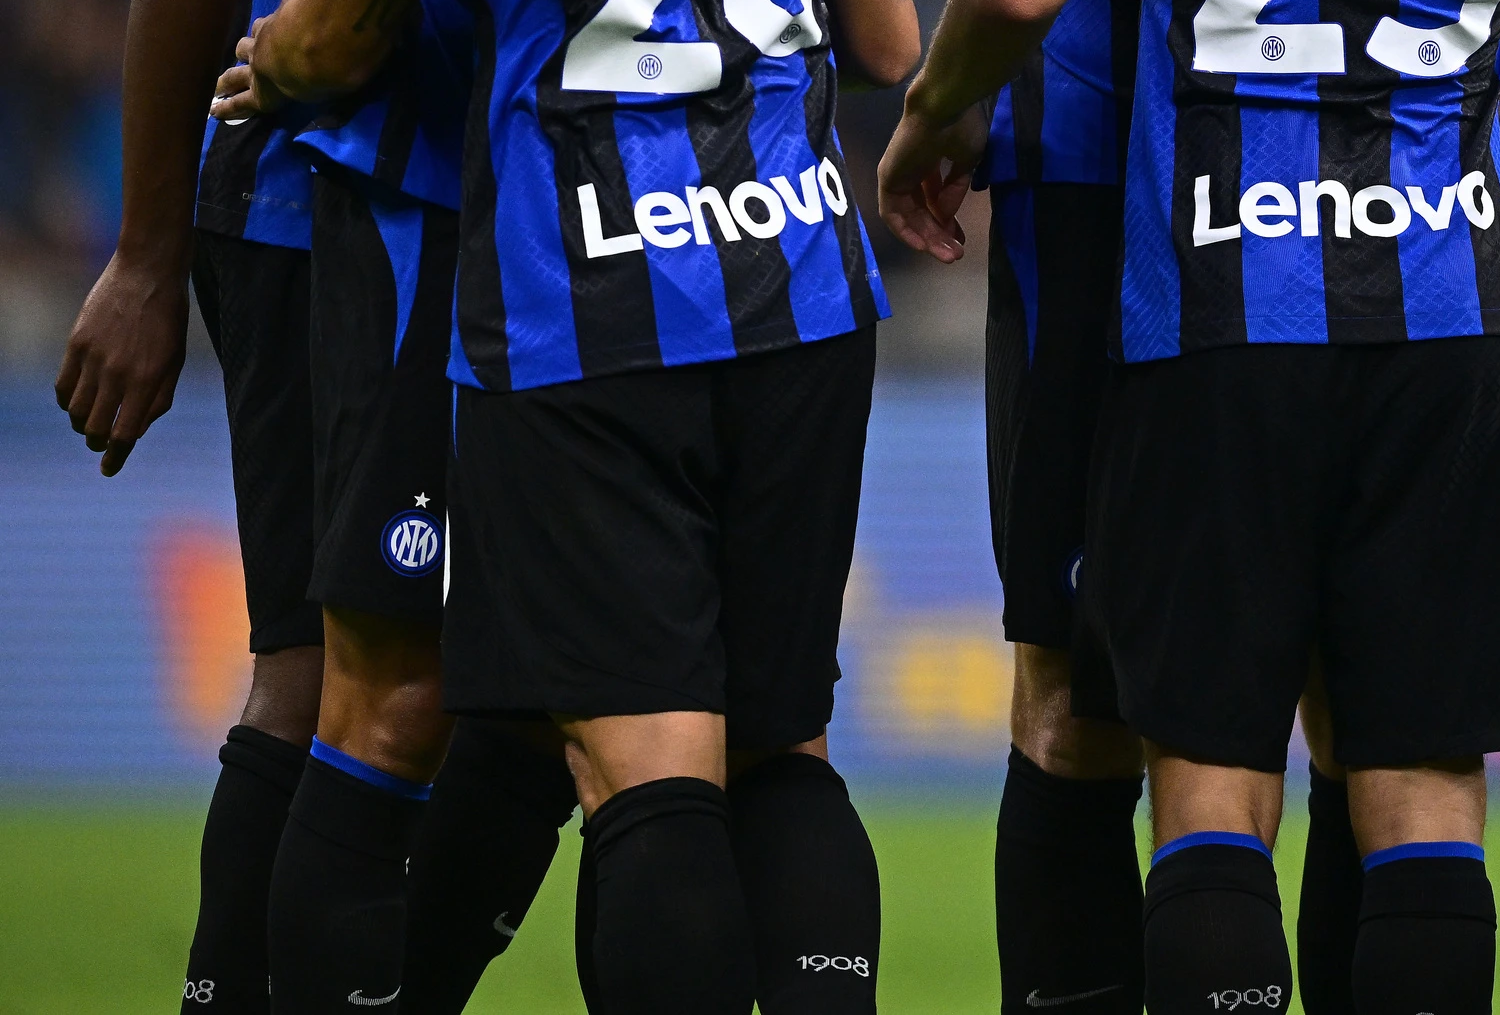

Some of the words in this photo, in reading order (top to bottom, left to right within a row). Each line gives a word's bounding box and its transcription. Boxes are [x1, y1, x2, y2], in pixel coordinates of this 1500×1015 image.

[577, 156, 848, 259] Lenovo
[1193, 170, 1495, 247] Lenovo
[796, 954, 870, 977] 1908
[1207, 985, 1282, 1011] 1908
